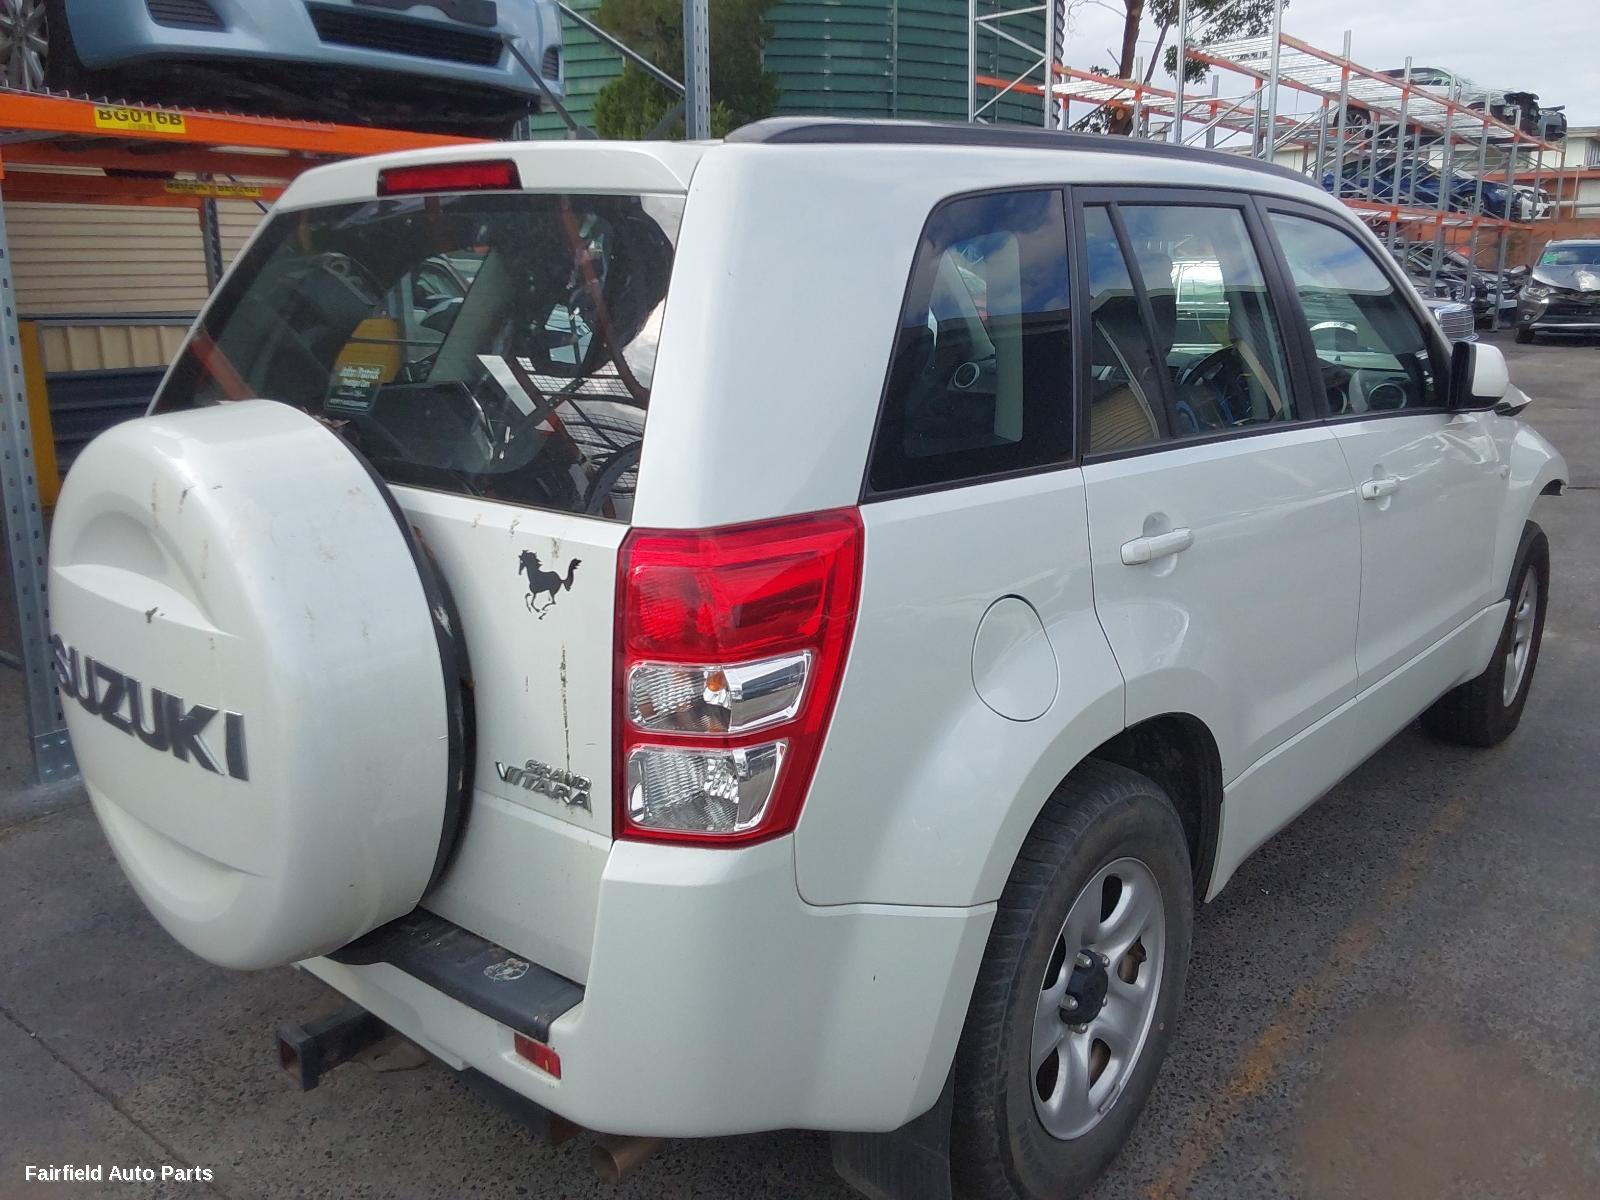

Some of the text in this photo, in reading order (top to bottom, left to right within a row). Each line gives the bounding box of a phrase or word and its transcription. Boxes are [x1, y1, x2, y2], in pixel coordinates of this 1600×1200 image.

[98, 107, 183, 126] BG016B
[50, 633, 249, 781] SUZUKI
[495, 761, 592, 813] VITARA
[525, 760, 592, 790] GRAND
